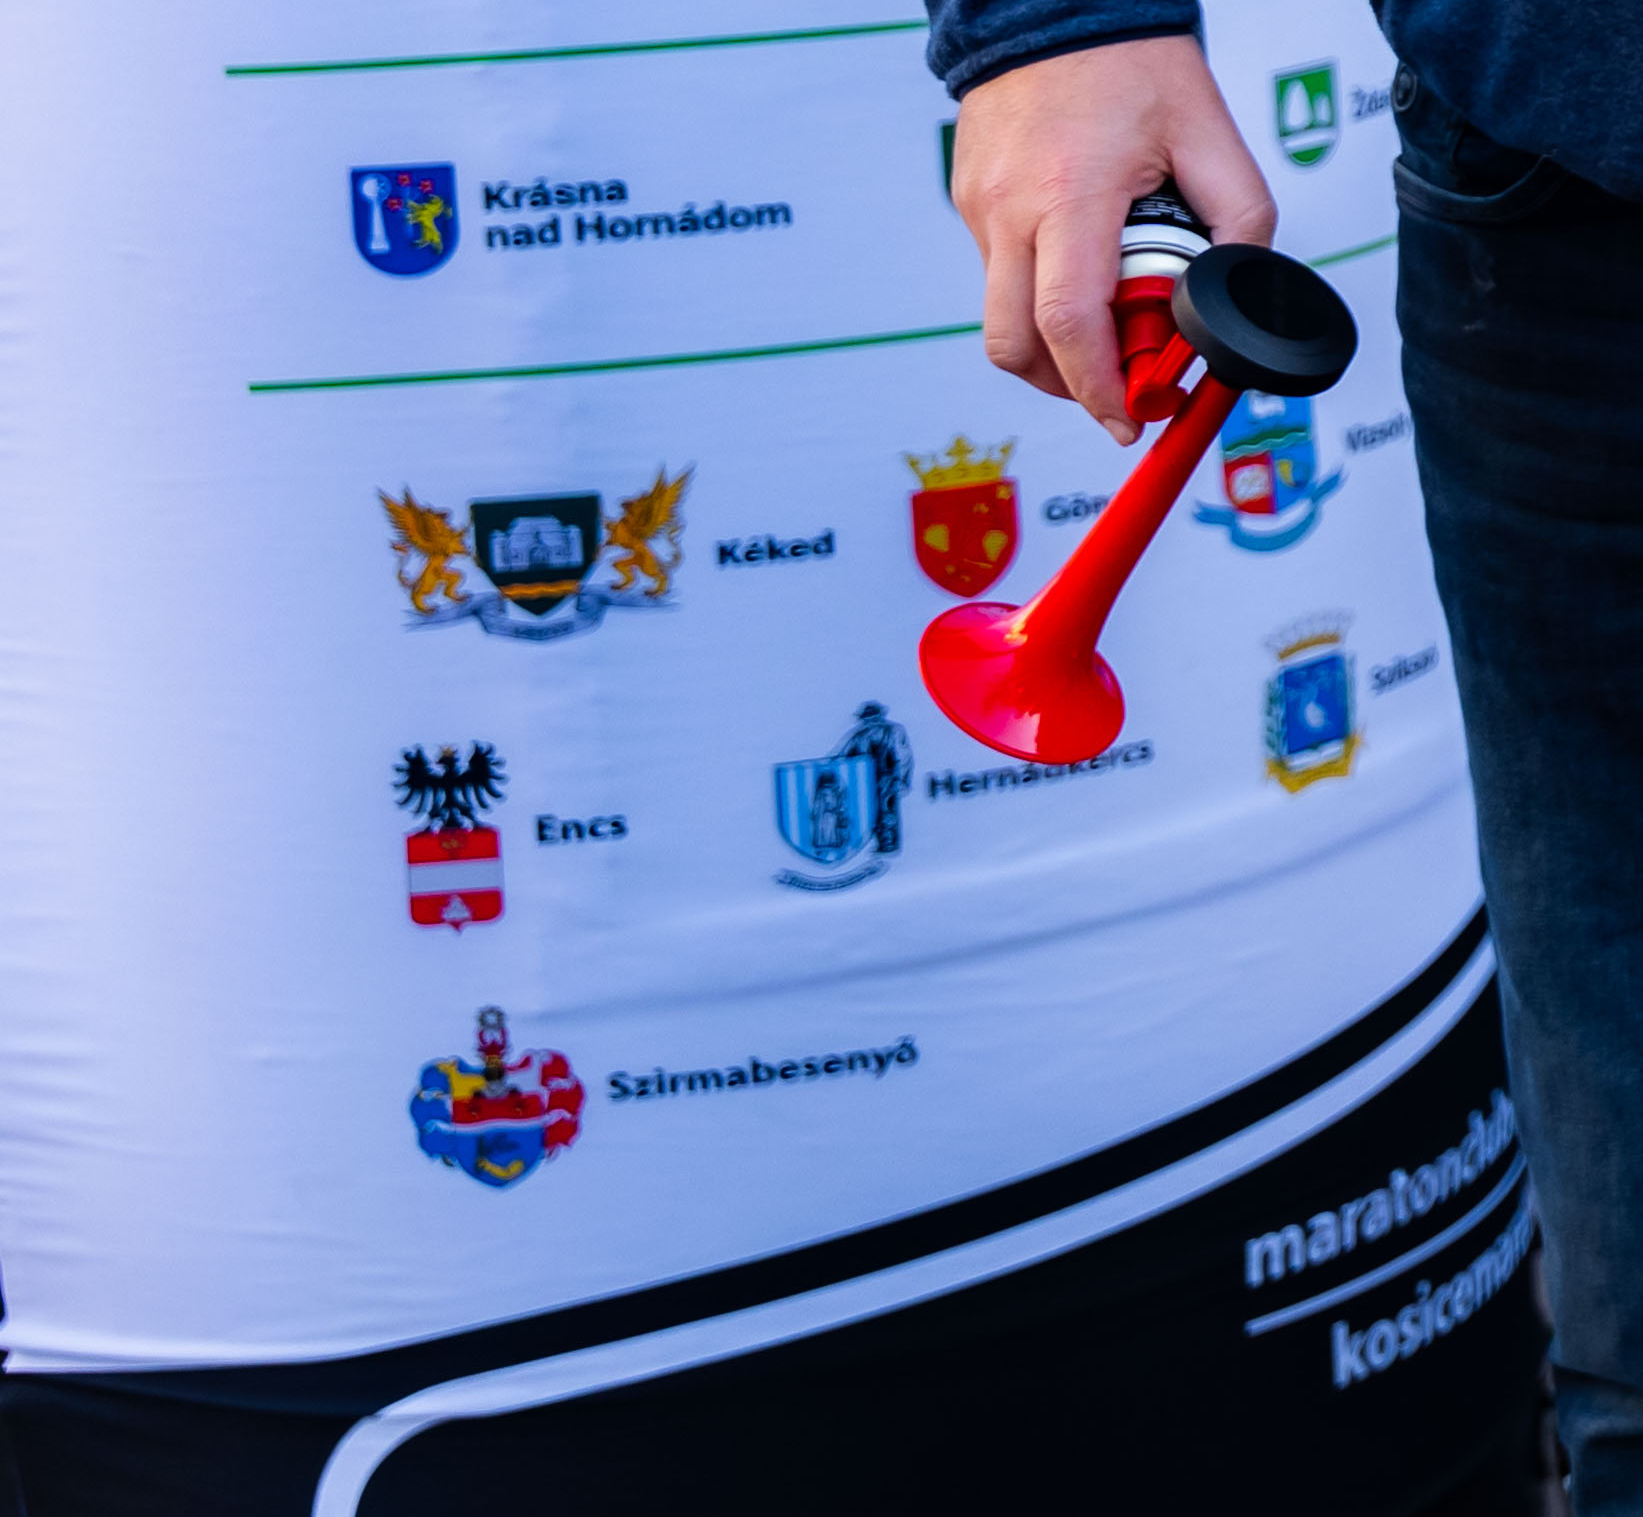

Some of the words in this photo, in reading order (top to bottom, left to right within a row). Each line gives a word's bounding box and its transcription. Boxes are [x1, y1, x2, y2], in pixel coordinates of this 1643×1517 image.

[482, 172, 628, 212] Krásna
[486, 216, 561, 250] nad
[574, 200, 793, 244] Hornádom
[715, 526, 837, 568] Kéked
[535, 812, 630, 848] Encs
[606, 1032, 919, 1104] Szirmabesenyő
